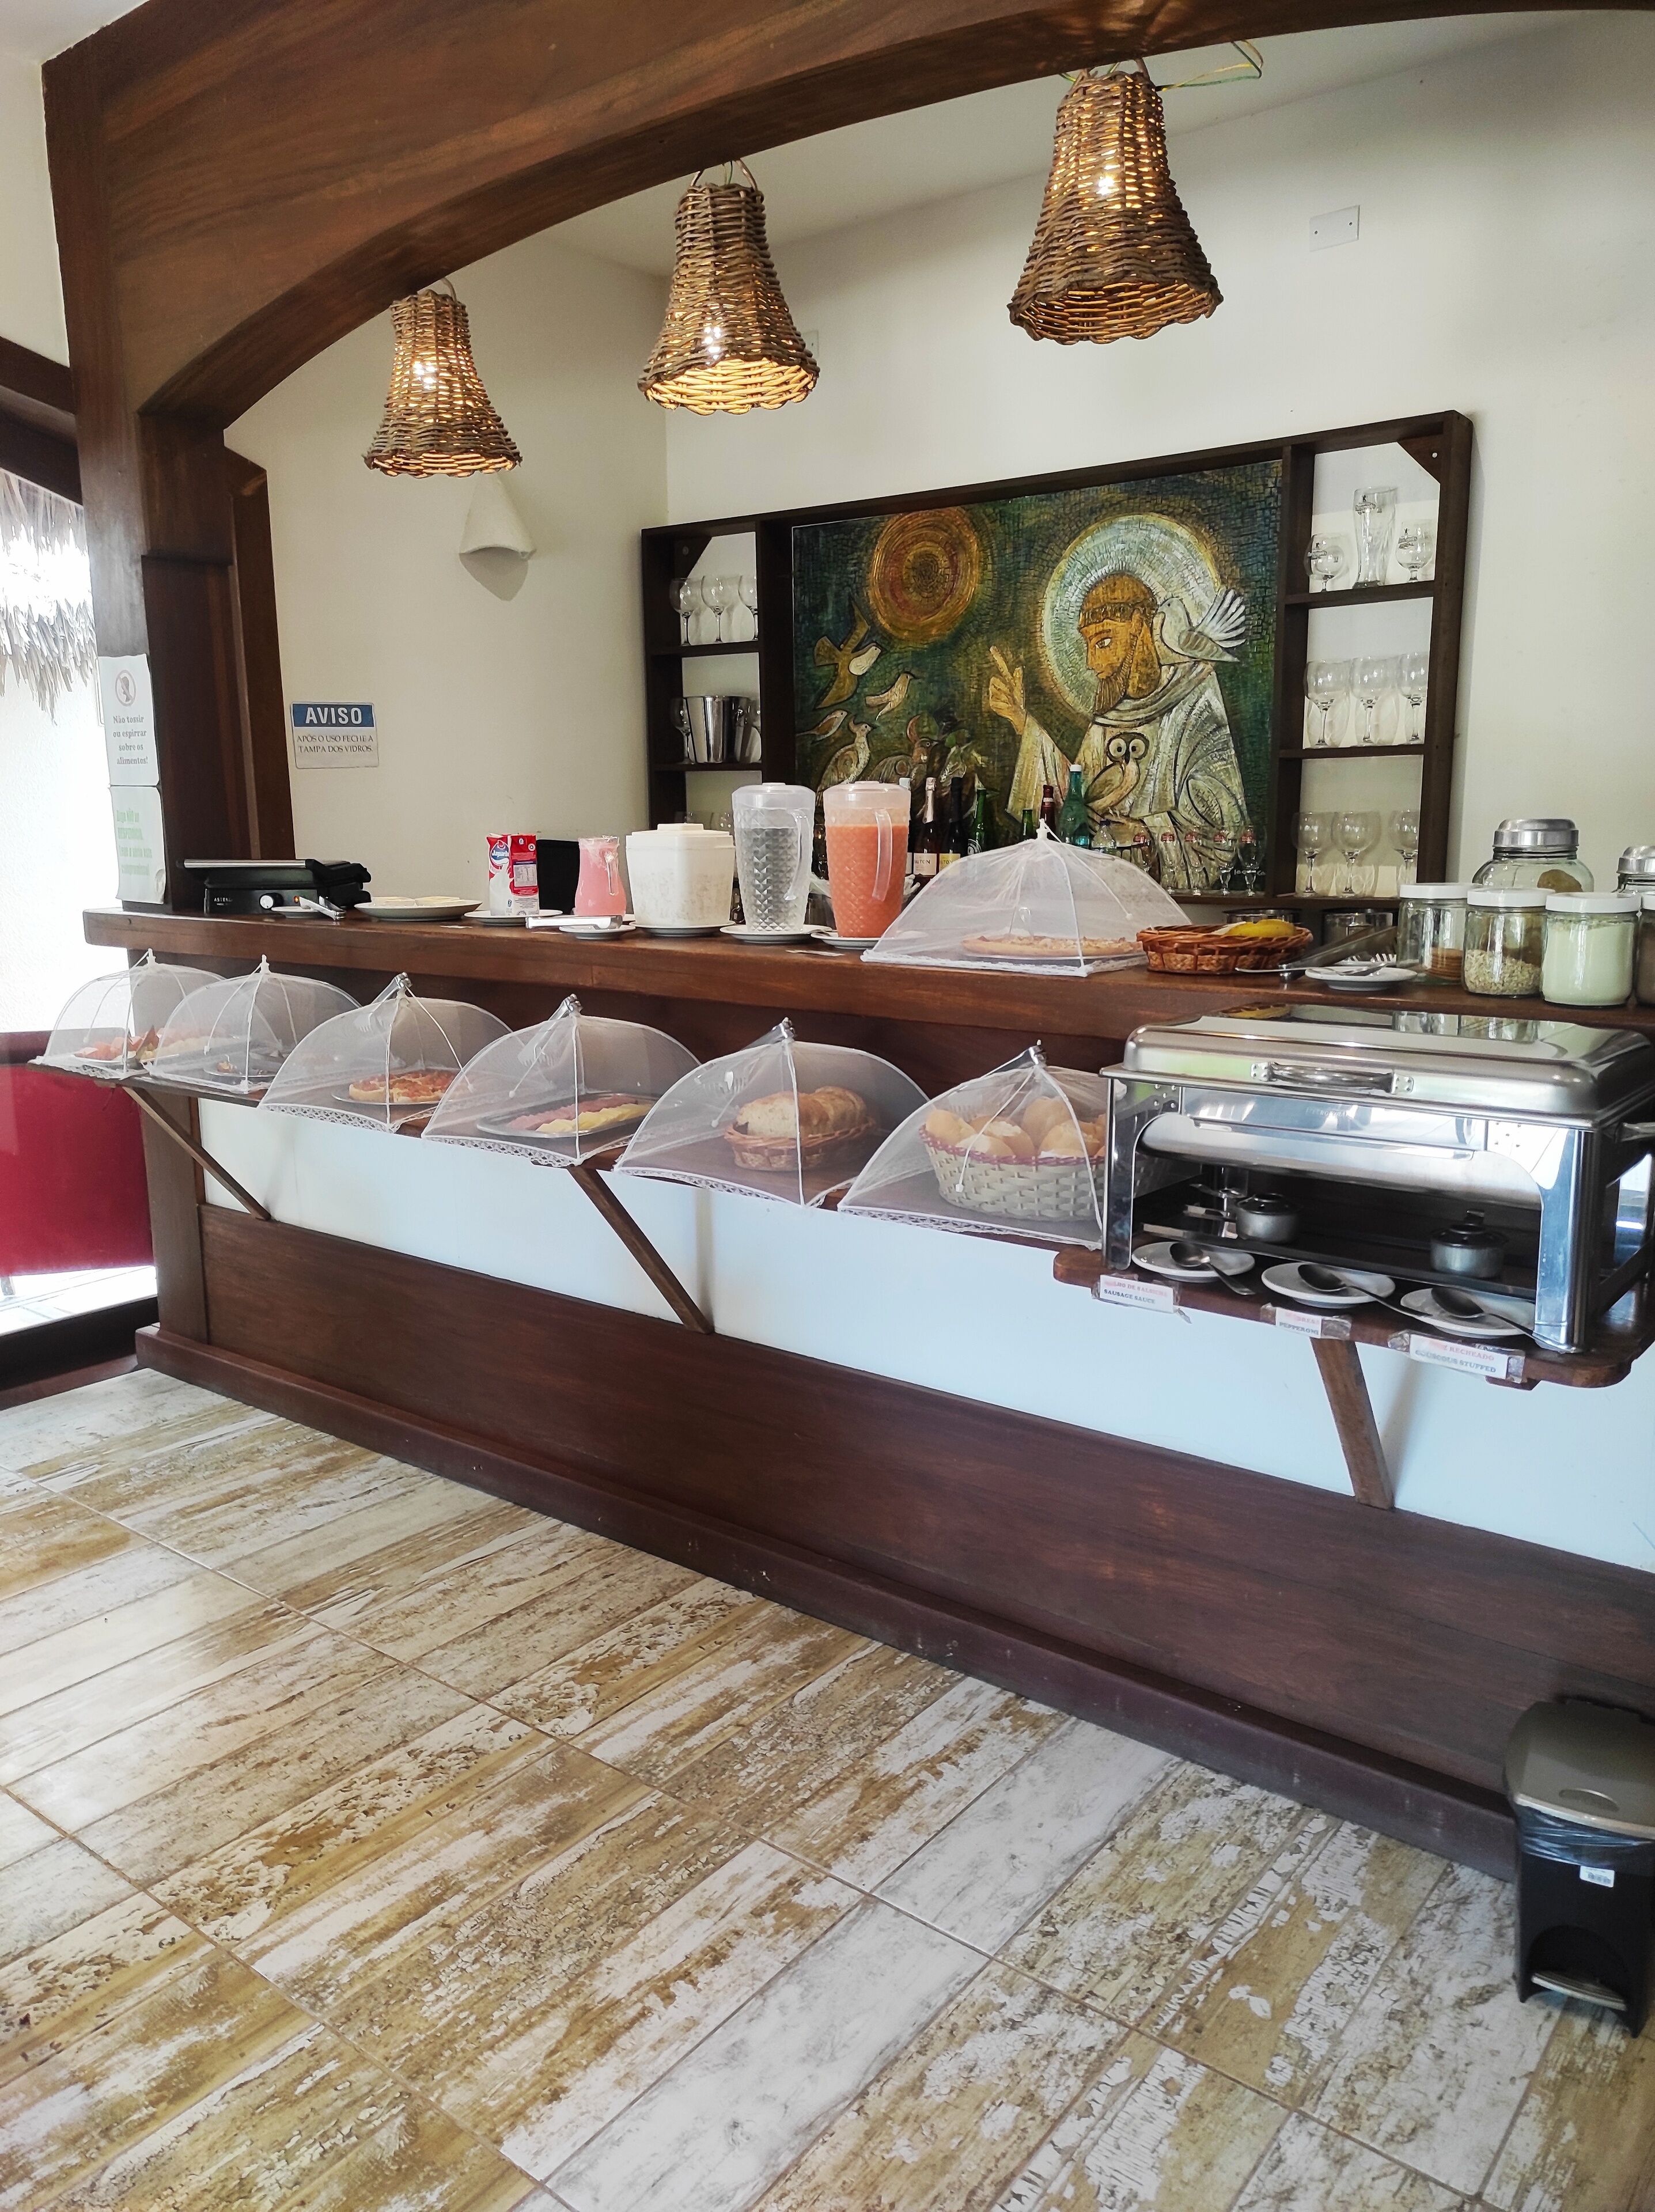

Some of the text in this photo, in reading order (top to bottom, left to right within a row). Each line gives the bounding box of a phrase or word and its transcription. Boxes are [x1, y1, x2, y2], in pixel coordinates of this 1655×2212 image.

[113, 715, 145, 724] Não tossir
[305, 707, 362, 725] AVISO
[122, 729, 147, 738] espirrar
[119, 743, 136, 751] sobre
[116, 756, 149, 764] alimentos!
[1104, 1289, 1155, 1304] SAUSAGE SAUCE
[1279, 1321, 1319, 1335] PEPPERONI
[1449, 1346, 1494, 1361] RECHEADO
[1459, 1359, 1497, 1373] STUFFED
